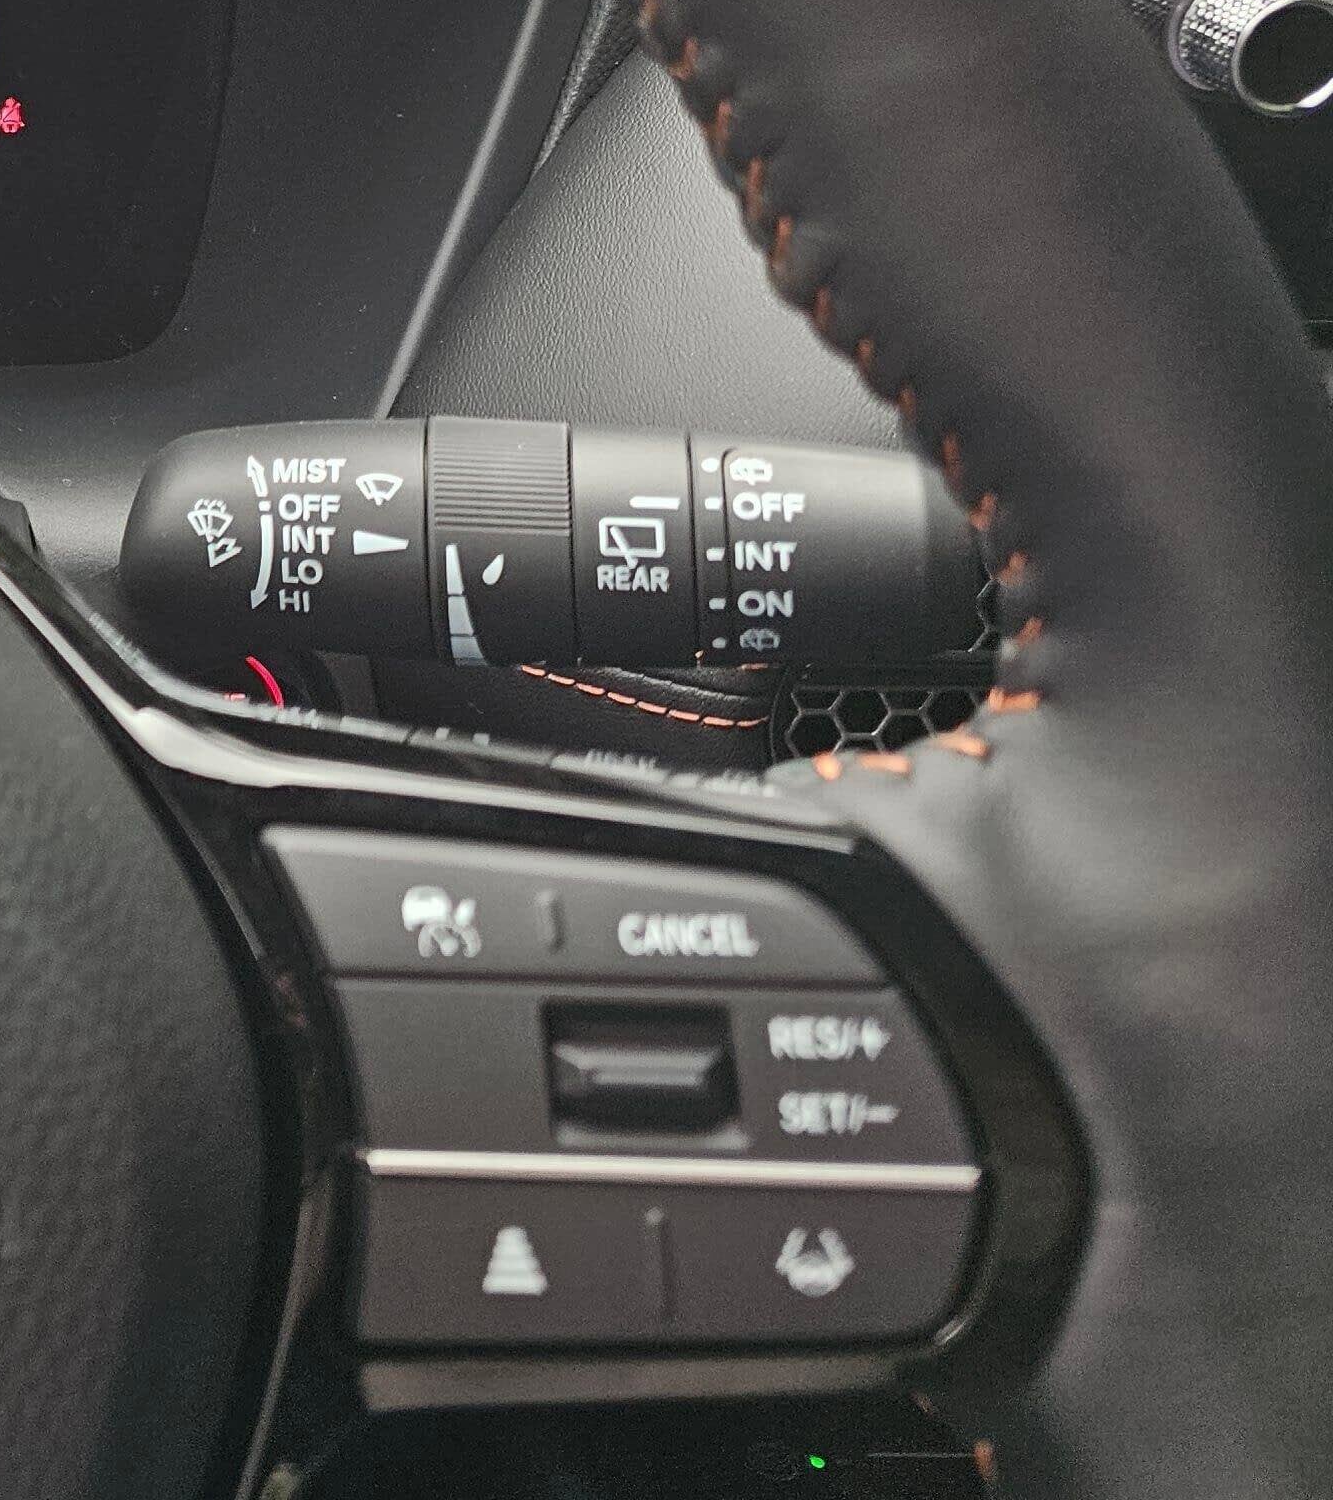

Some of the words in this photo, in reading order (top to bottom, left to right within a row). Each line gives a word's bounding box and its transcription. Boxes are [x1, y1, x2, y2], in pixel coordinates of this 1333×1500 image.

[272, 457, 347, 484] MIST
[278, 494, 342, 522] OFF
[732, 492, 806, 522] OFF
[282, 525, 337, 555] INT
[734, 541, 798, 572] INT
[281, 557, 324, 585] LO
[596, 564, 670, 593] REAR
[278, 590, 310, 613] HI
[737, 590, 794, 618] ON
[617, 912, 760, 958] CANCEL
